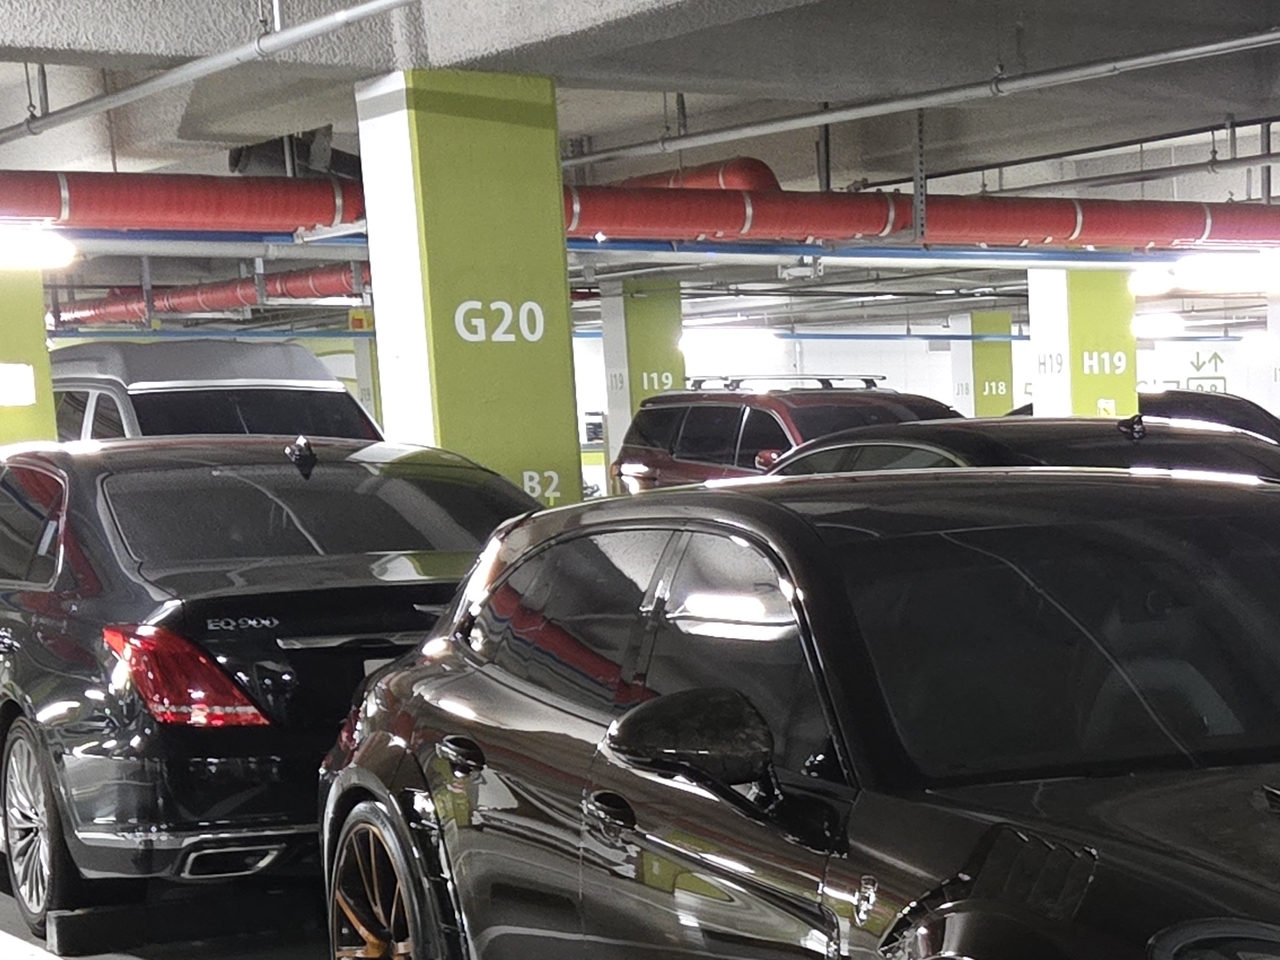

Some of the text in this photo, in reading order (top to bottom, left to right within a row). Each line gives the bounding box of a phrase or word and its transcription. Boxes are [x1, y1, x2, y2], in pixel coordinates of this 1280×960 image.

[454, 300, 544, 342] G20
[1038, 353, 1063, 374] H19
[1083, 350, 1127, 375] H19
[642, 371, 673, 390] I19
[982, 381, 1007, 396] J18
[523, 470, 561, 498] B2
